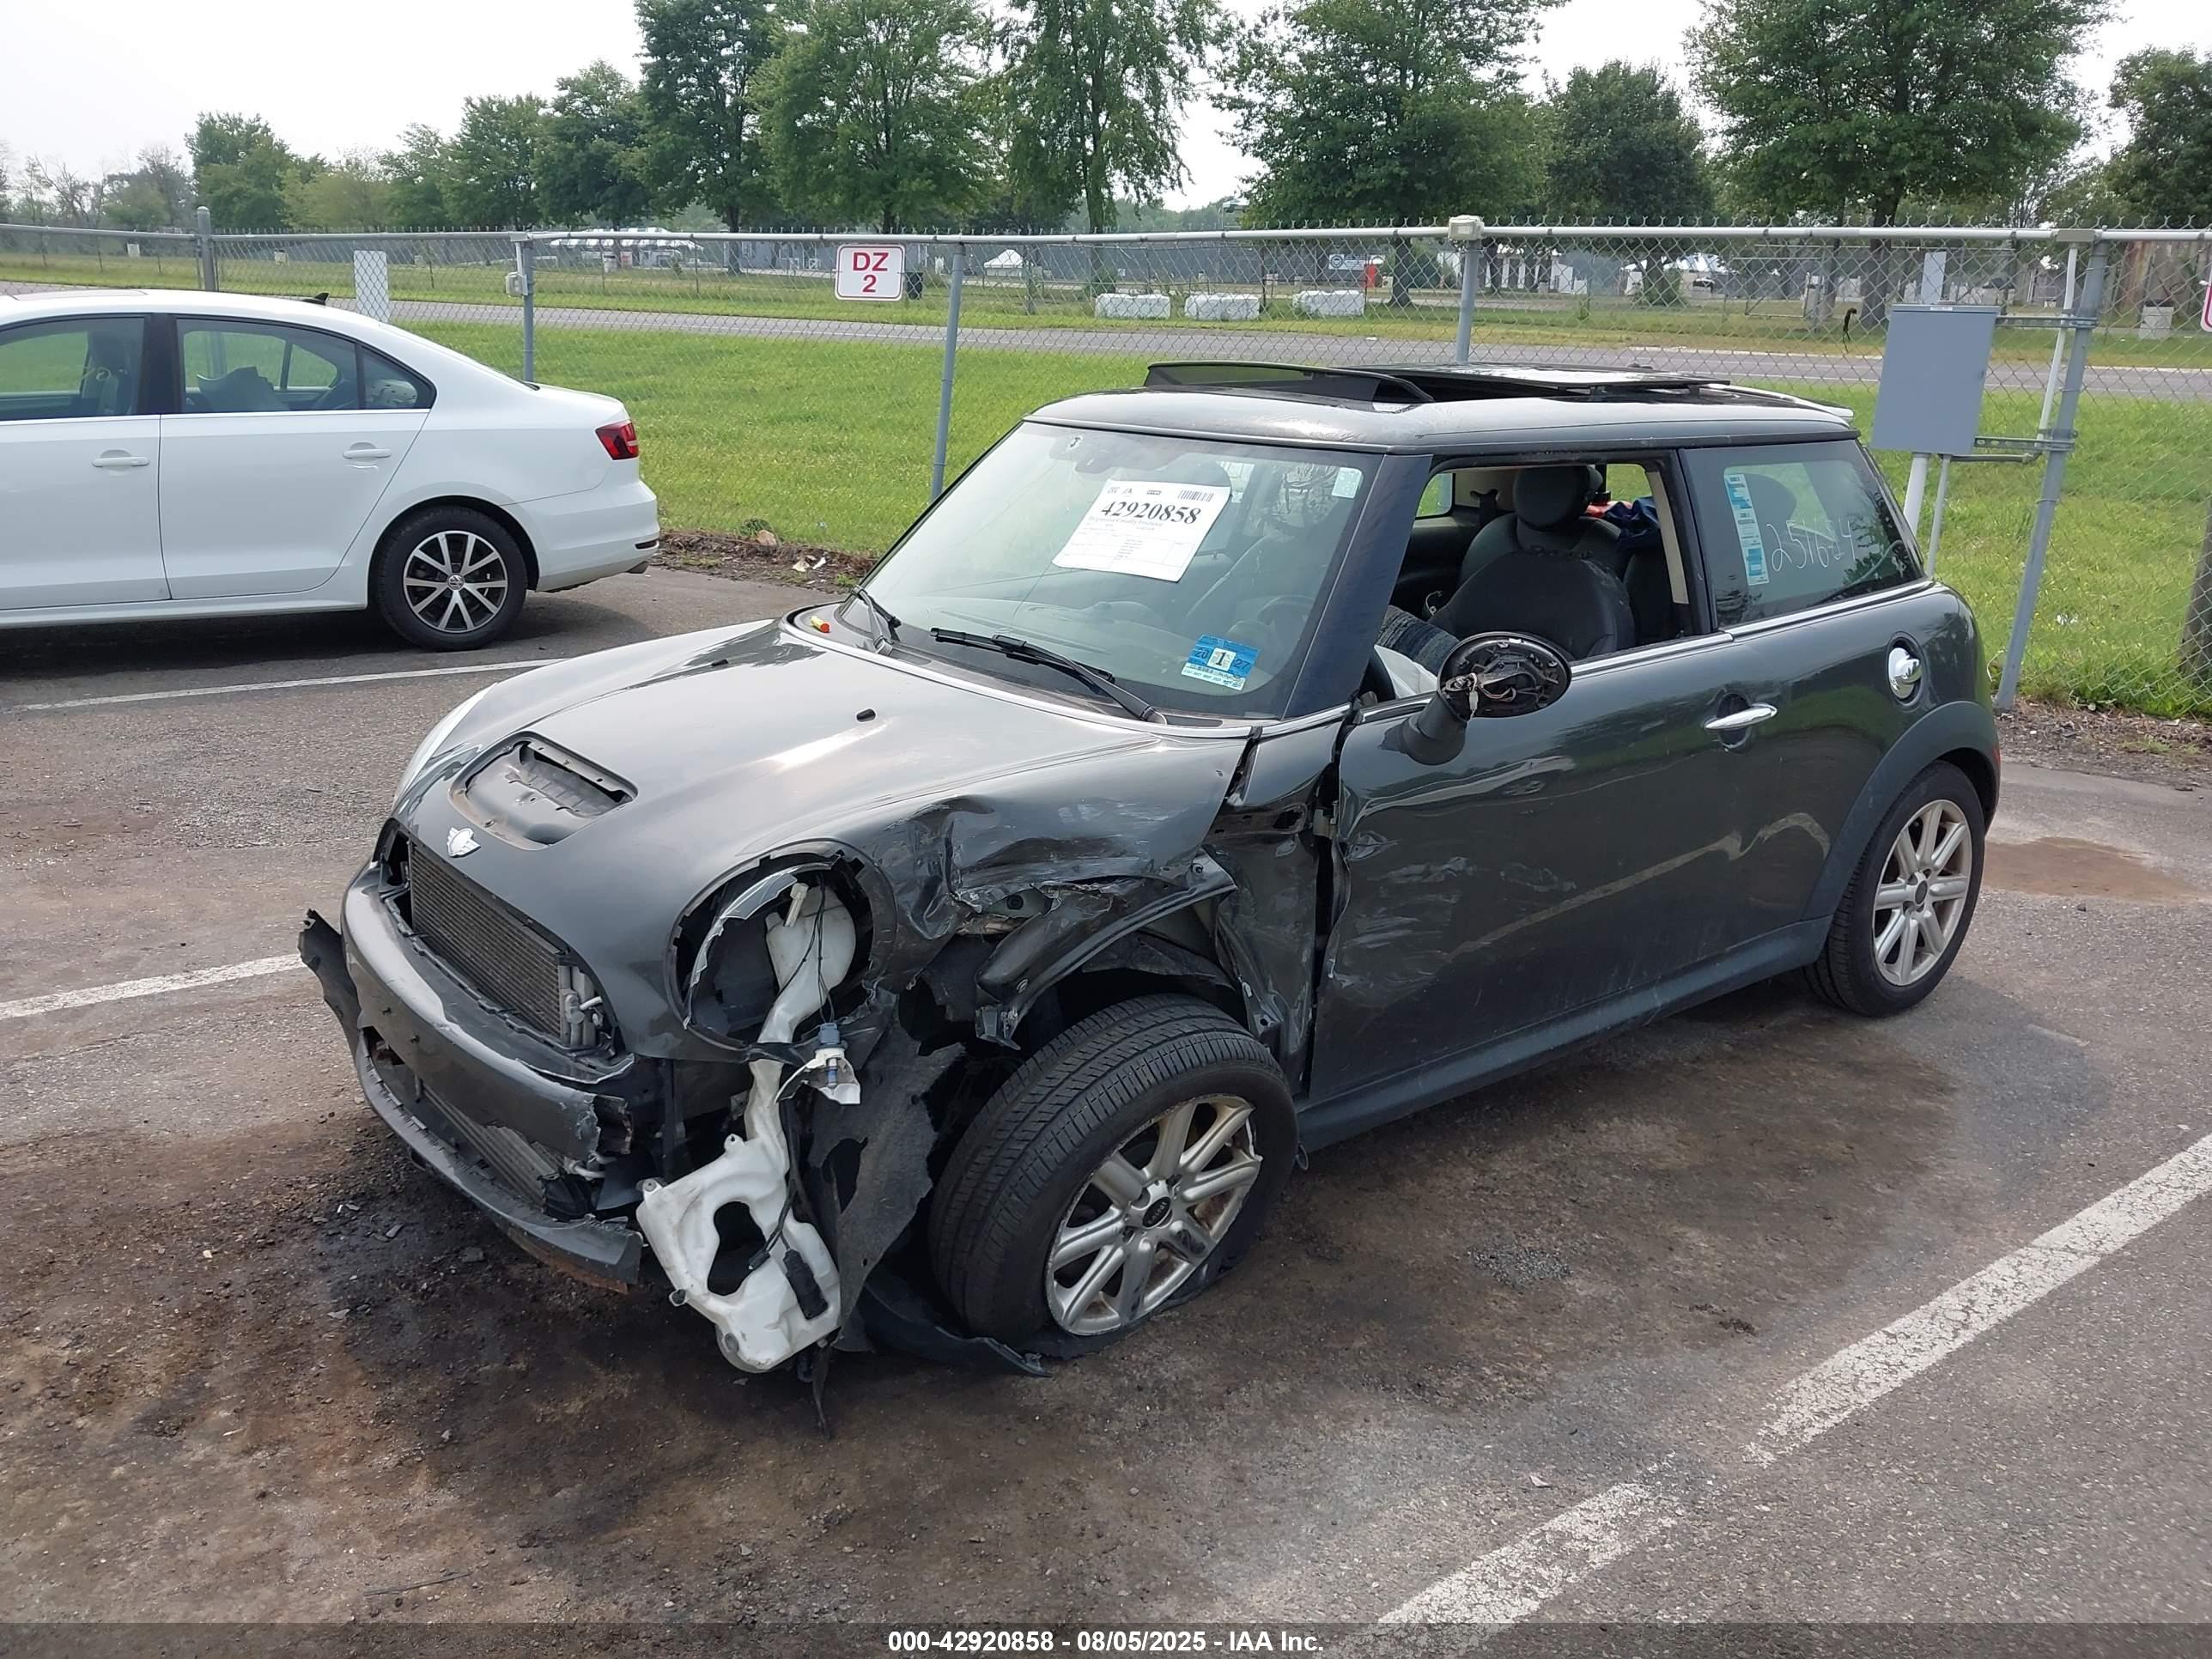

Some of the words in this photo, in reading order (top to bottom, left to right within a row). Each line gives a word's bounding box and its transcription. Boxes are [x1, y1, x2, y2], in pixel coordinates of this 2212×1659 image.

[853, 252, 890, 271] DZ
[862, 274, 877, 293] 2
[1101, 501, 1201, 525] 42920858
[1215, 651, 1226, 666] 1
[1234, 658, 1251, 670] 27
